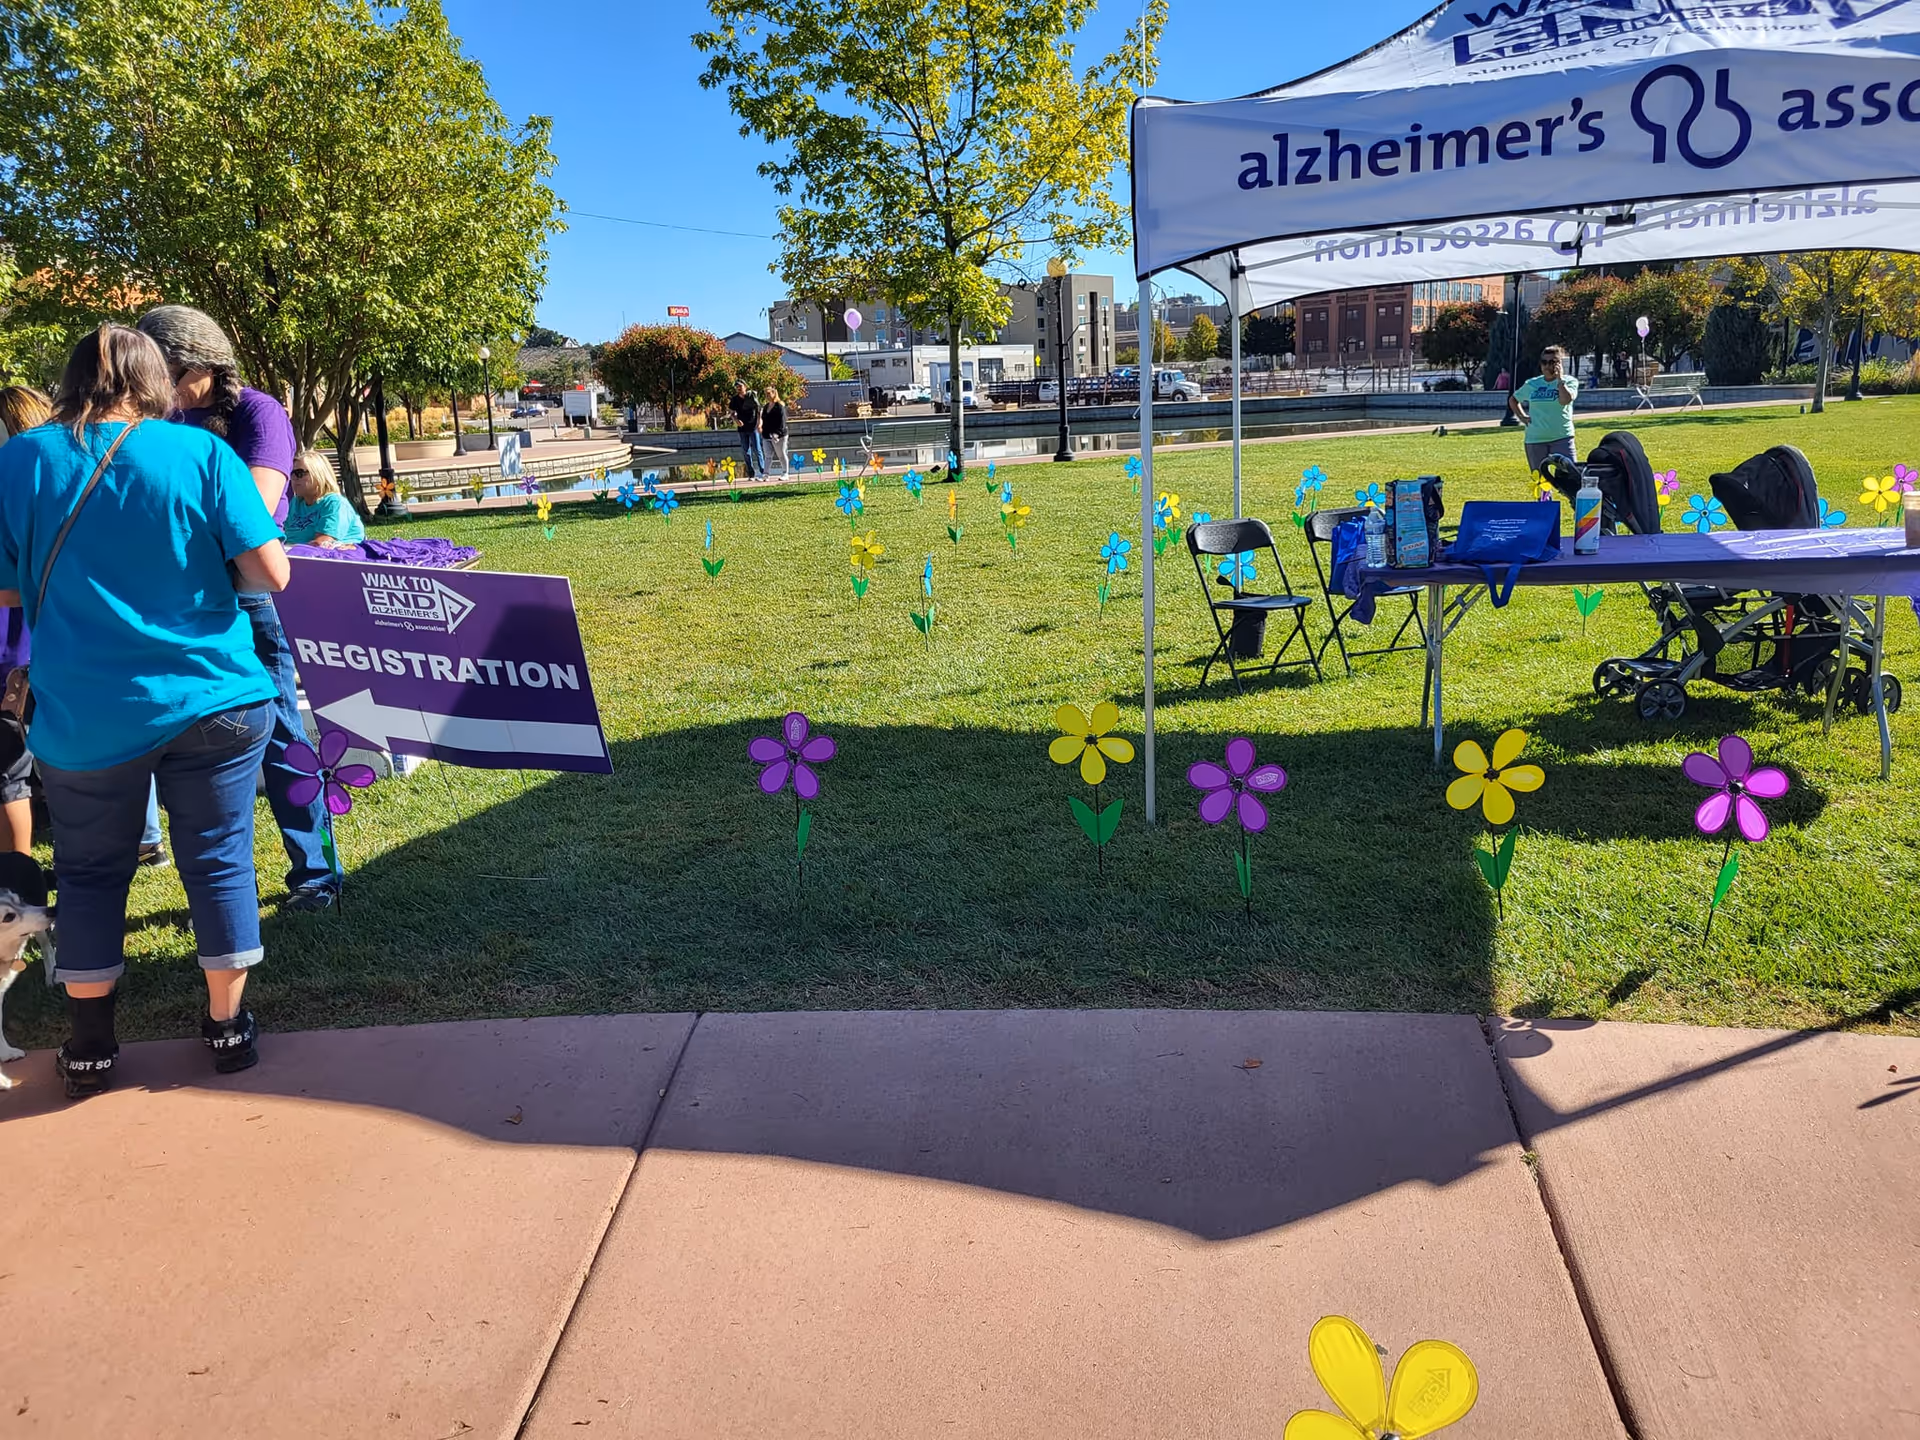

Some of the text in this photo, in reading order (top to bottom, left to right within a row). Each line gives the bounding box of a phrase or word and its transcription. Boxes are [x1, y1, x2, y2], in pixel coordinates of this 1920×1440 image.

[1466, 4, 1790, 64] ALZHEIMER'S
[1237, 97, 1605, 190] alzheimer's
[361, 572, 432, 592] WALK TO
[367, 589, 436, 610] END
[371, 605, 439, 619] ALZHEIMER'S
[294, 637, 580, 690] REGISTRATION
[95, 1059, 112, 1070] SO
